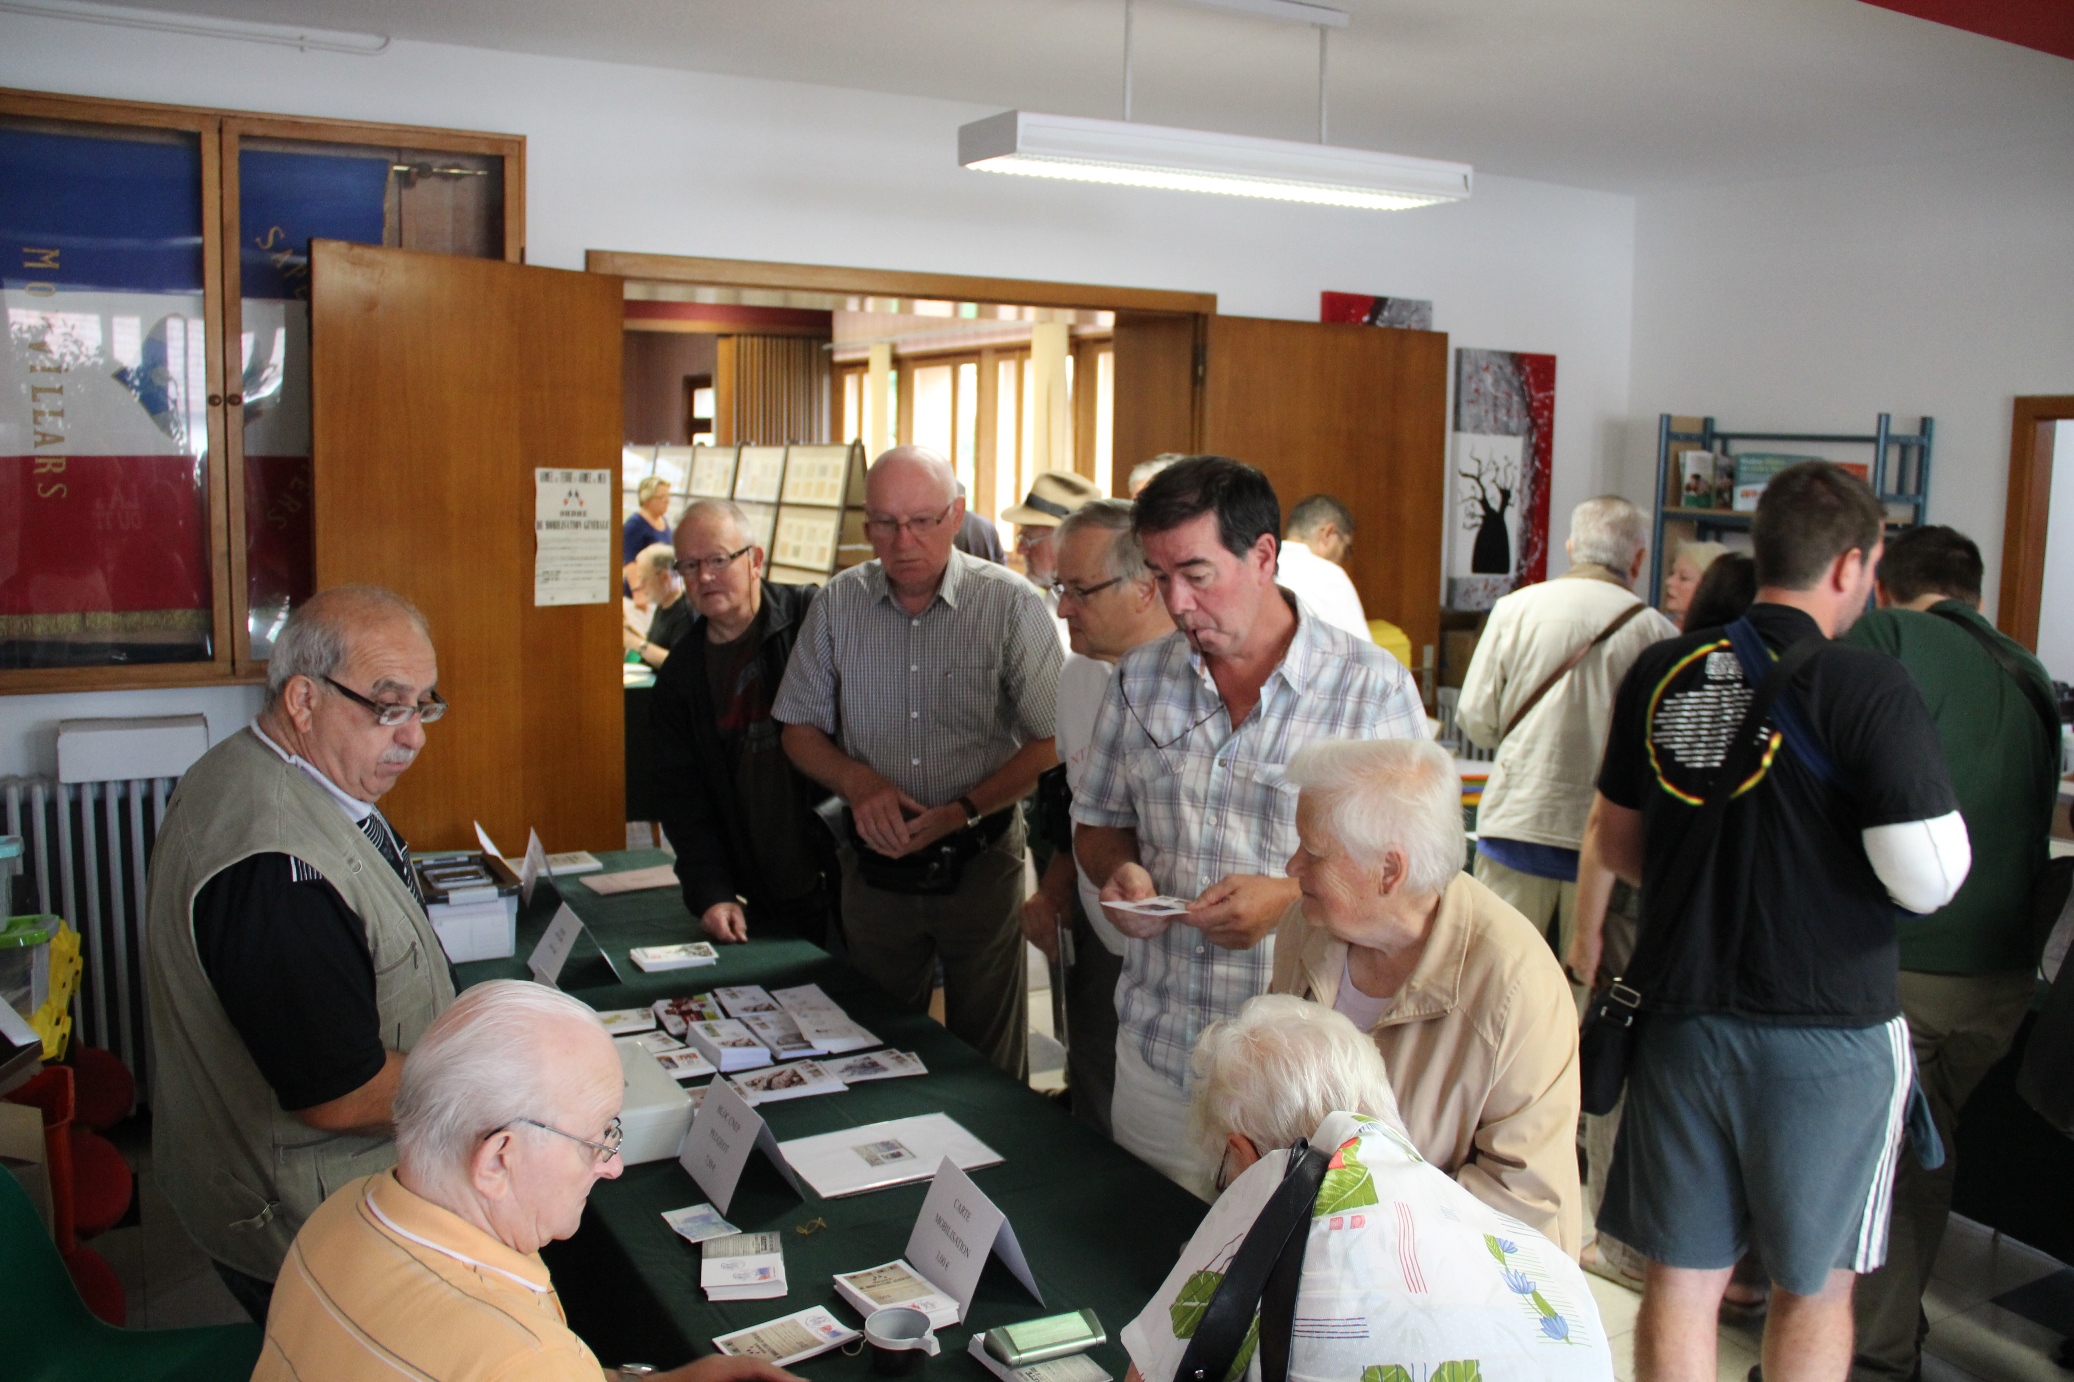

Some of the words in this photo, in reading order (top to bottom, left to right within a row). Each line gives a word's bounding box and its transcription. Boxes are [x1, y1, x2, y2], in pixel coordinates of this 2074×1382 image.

[23, 248, 68, 498] MOVILLARS
[953, 1198, 972, 1223] CARTE
[934, 1212, 971, 1259] MOBILISATION
